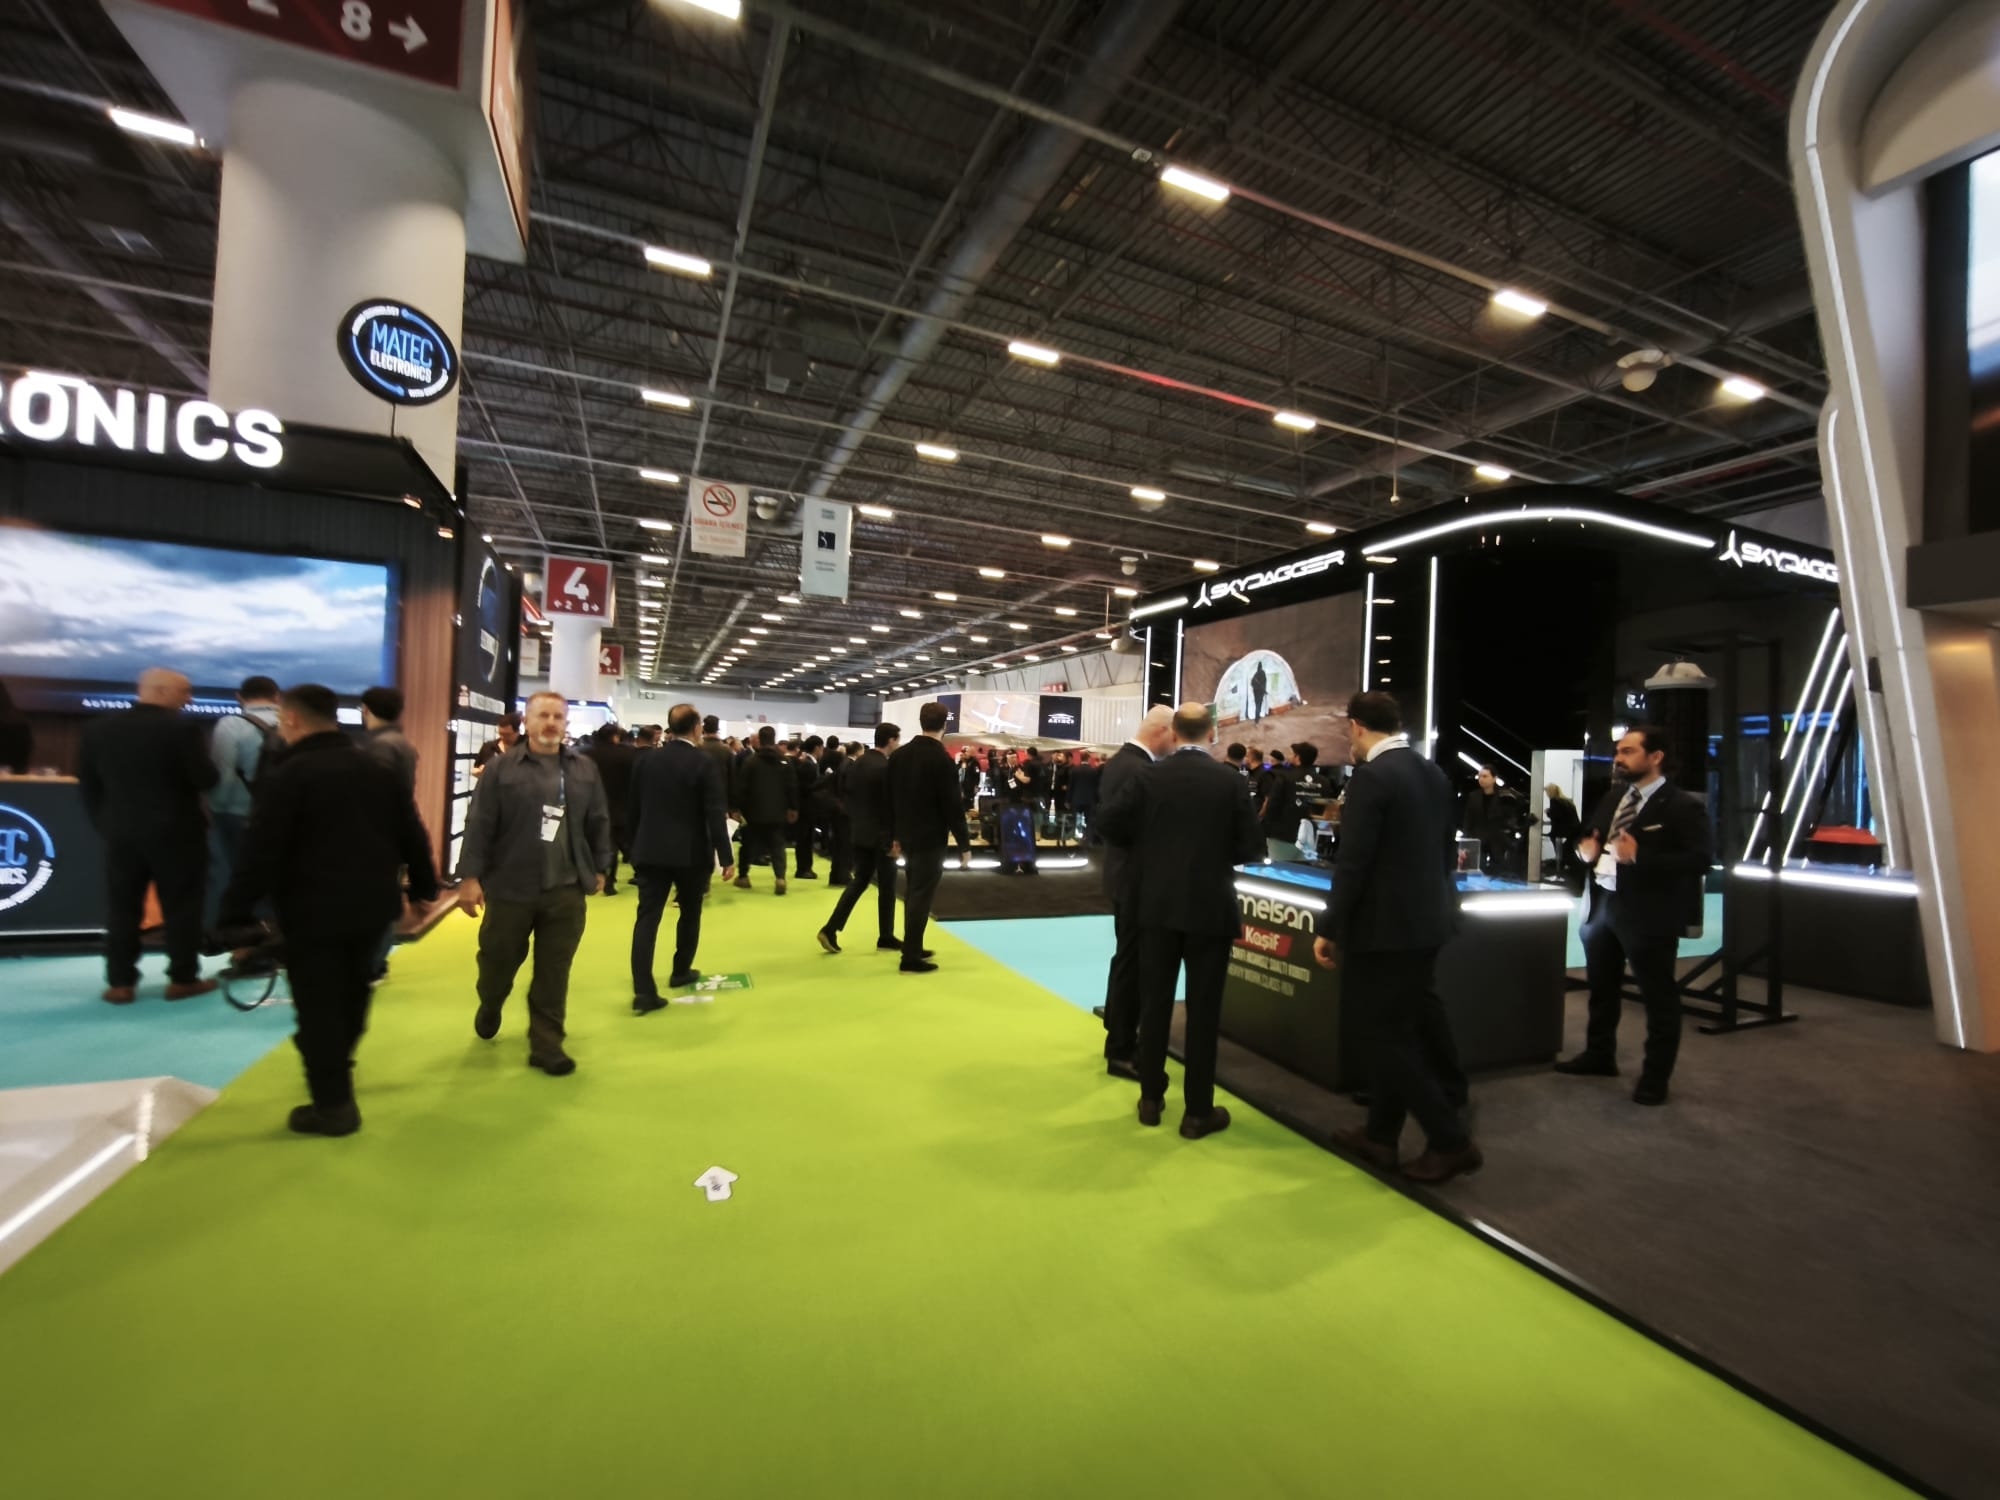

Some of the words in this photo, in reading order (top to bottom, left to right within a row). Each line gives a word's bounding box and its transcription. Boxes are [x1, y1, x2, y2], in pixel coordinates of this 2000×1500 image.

[341, 0, 372, 41] 8
[371, 319, 434, 369] MATEC
[370, 347, 432, 384] ELECTRONICS
[0, 375, 284, 468] ONICS
[1210, 549, 1345, 600] SKYDAGGER
[1741, 541, 1840, 583] SKYDAGG
[563, 566, 589, 600] 4
[564, 600, 573, 610] 2
